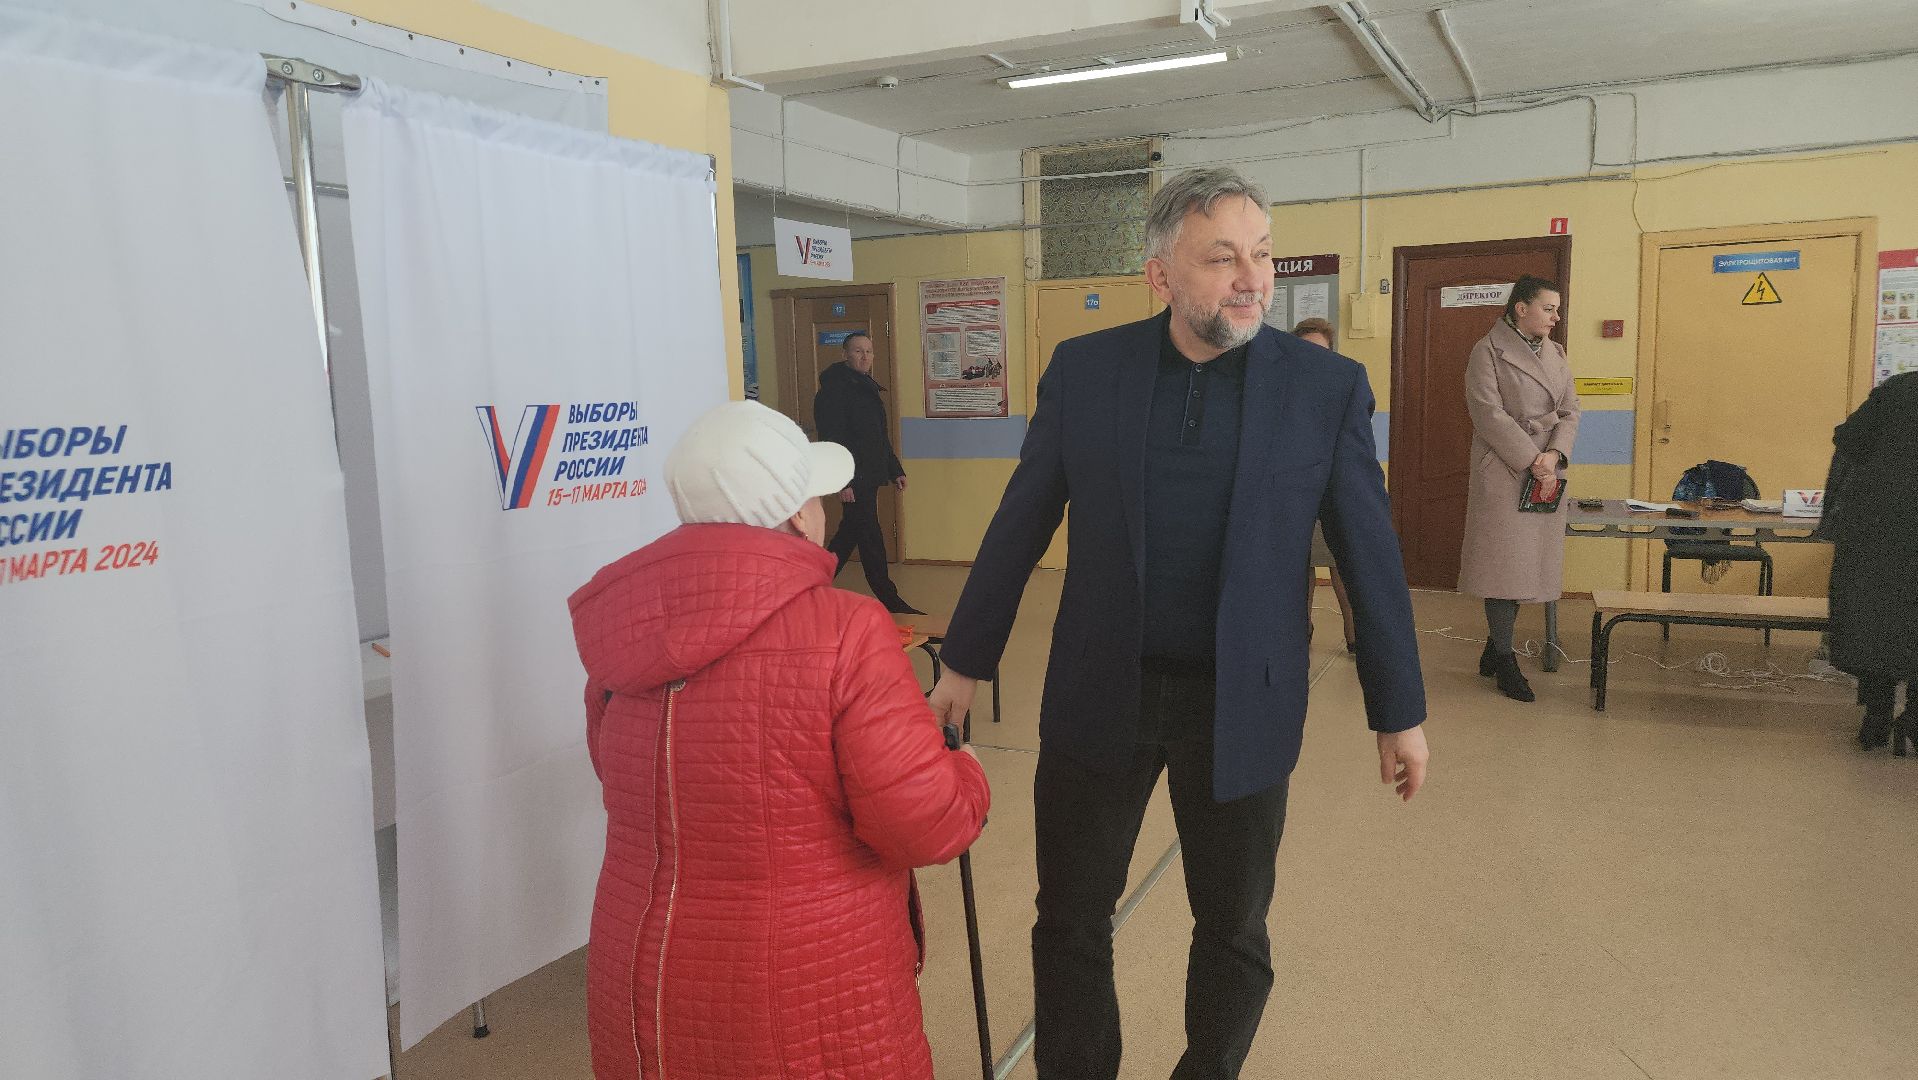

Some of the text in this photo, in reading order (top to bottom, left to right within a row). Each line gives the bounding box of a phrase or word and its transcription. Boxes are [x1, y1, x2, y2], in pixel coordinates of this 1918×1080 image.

[1457, 291, 1502, 301] ДИРЕКТОР
[568, 401, 638, 424] ВЫБОРЫ
[562, 425, 649, 452] ПРЕЗИДЕНТА
[554, 455, 626, 481] РОССИИ
[0, 462, 172, 503] ЕЗИДЕНТА
[581, 480, 628, 502] МАРТА
[0, 509, 83, 547] ССИИ
[8, 547, 89, 583] МАРТА
[94, 540, 160, 571] 2024
